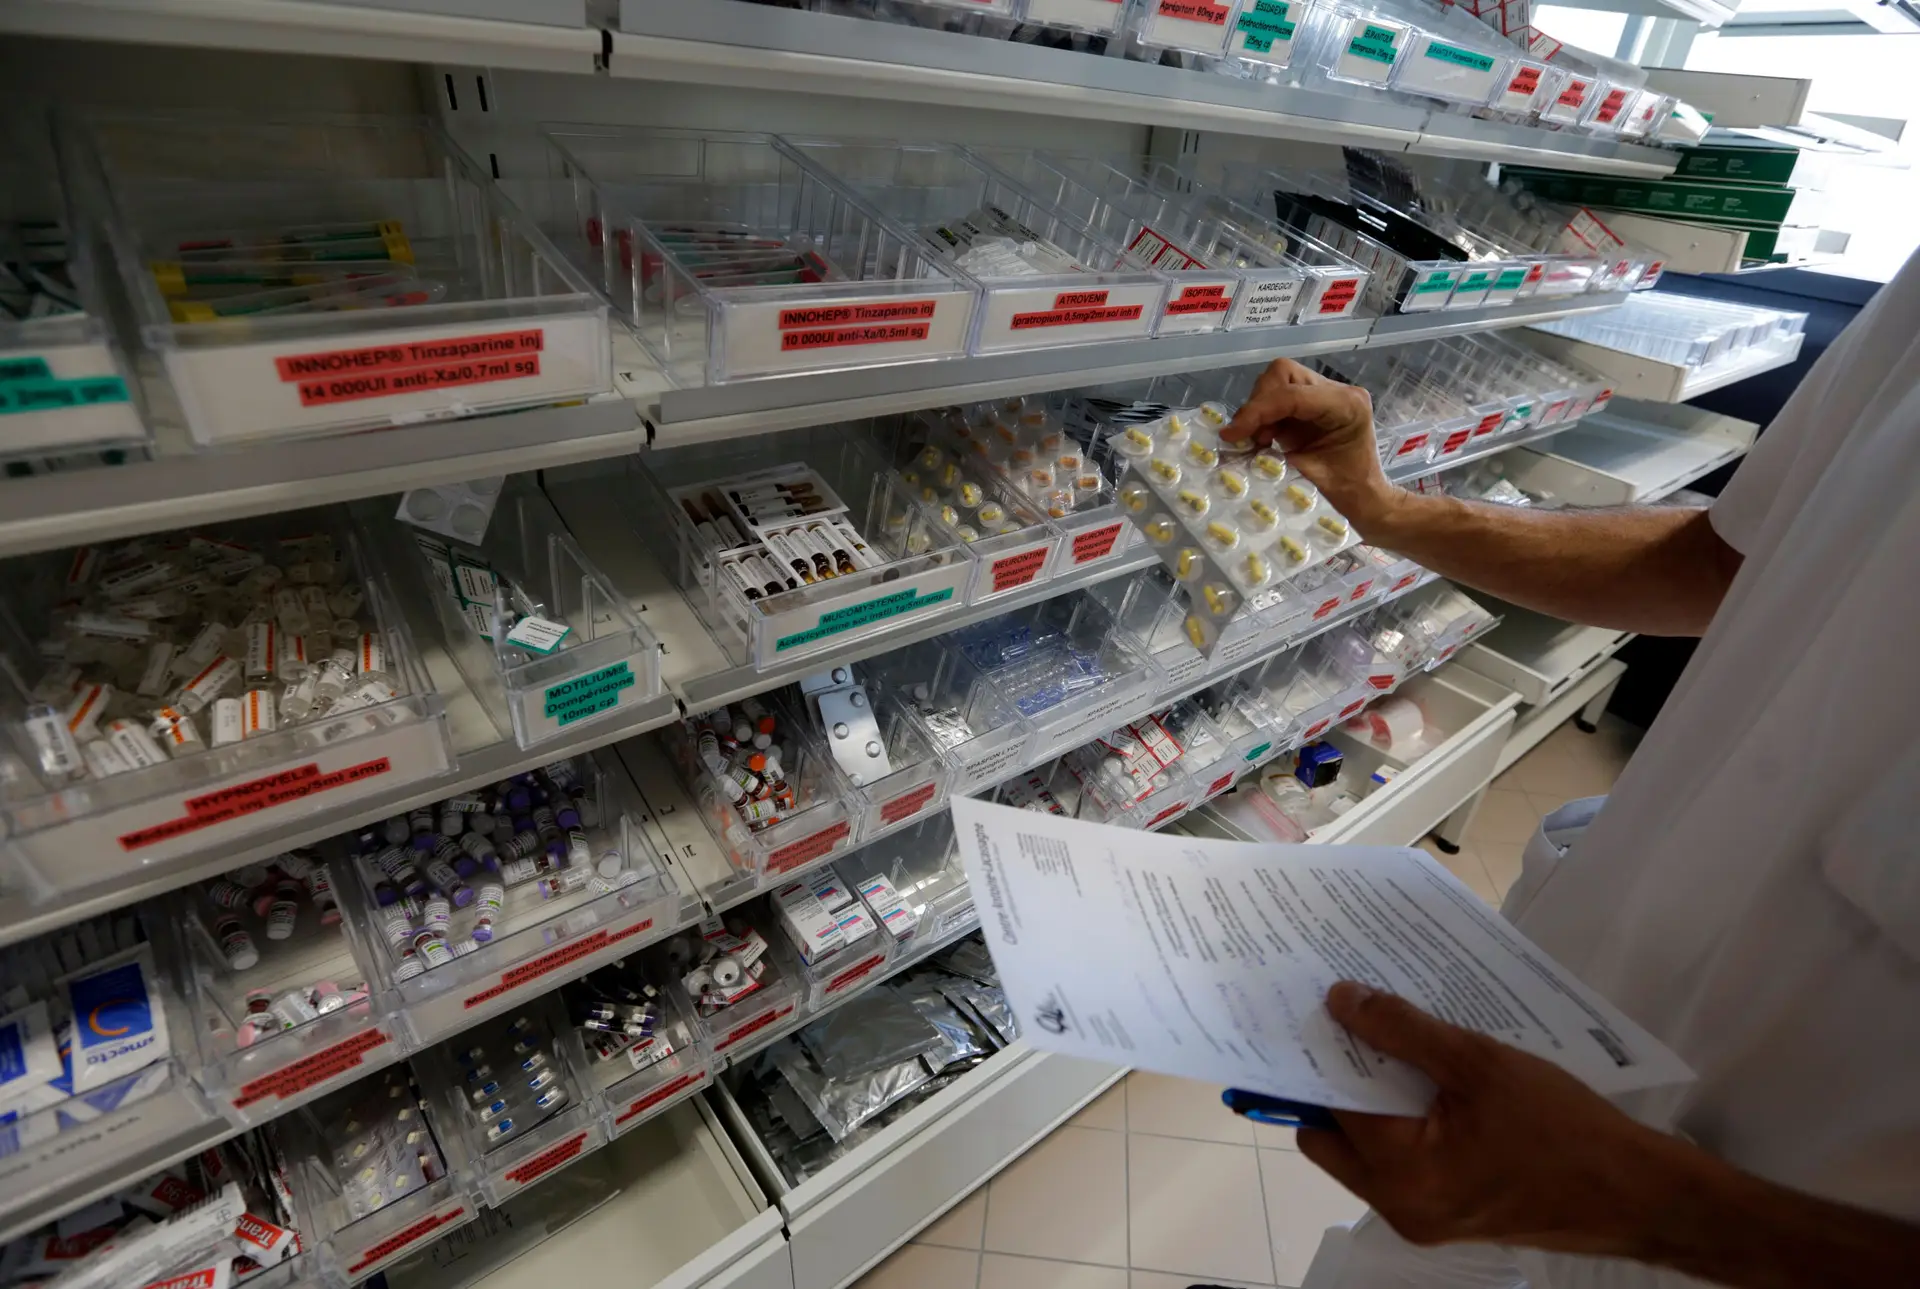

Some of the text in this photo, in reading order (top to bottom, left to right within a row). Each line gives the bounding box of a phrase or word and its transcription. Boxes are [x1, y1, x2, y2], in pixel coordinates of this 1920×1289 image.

[783, 302, 935, 326] INNOHEP® Tinzaparine inj
[783, 333, 799, 347] 10
[801, 330, 835, 346] 000UI
[910, 326, 924, 340] sg
[287, 331, 541, 376] INNOHEP® Tinzaparine inj
[301, 381, 325, 400] 14
[329, 375, 387, 398] 000UI
[513, 358, 535, 378] sg
[562, 696, 616, 722] 10mg cp
[348, 759, 387, 780] amp
